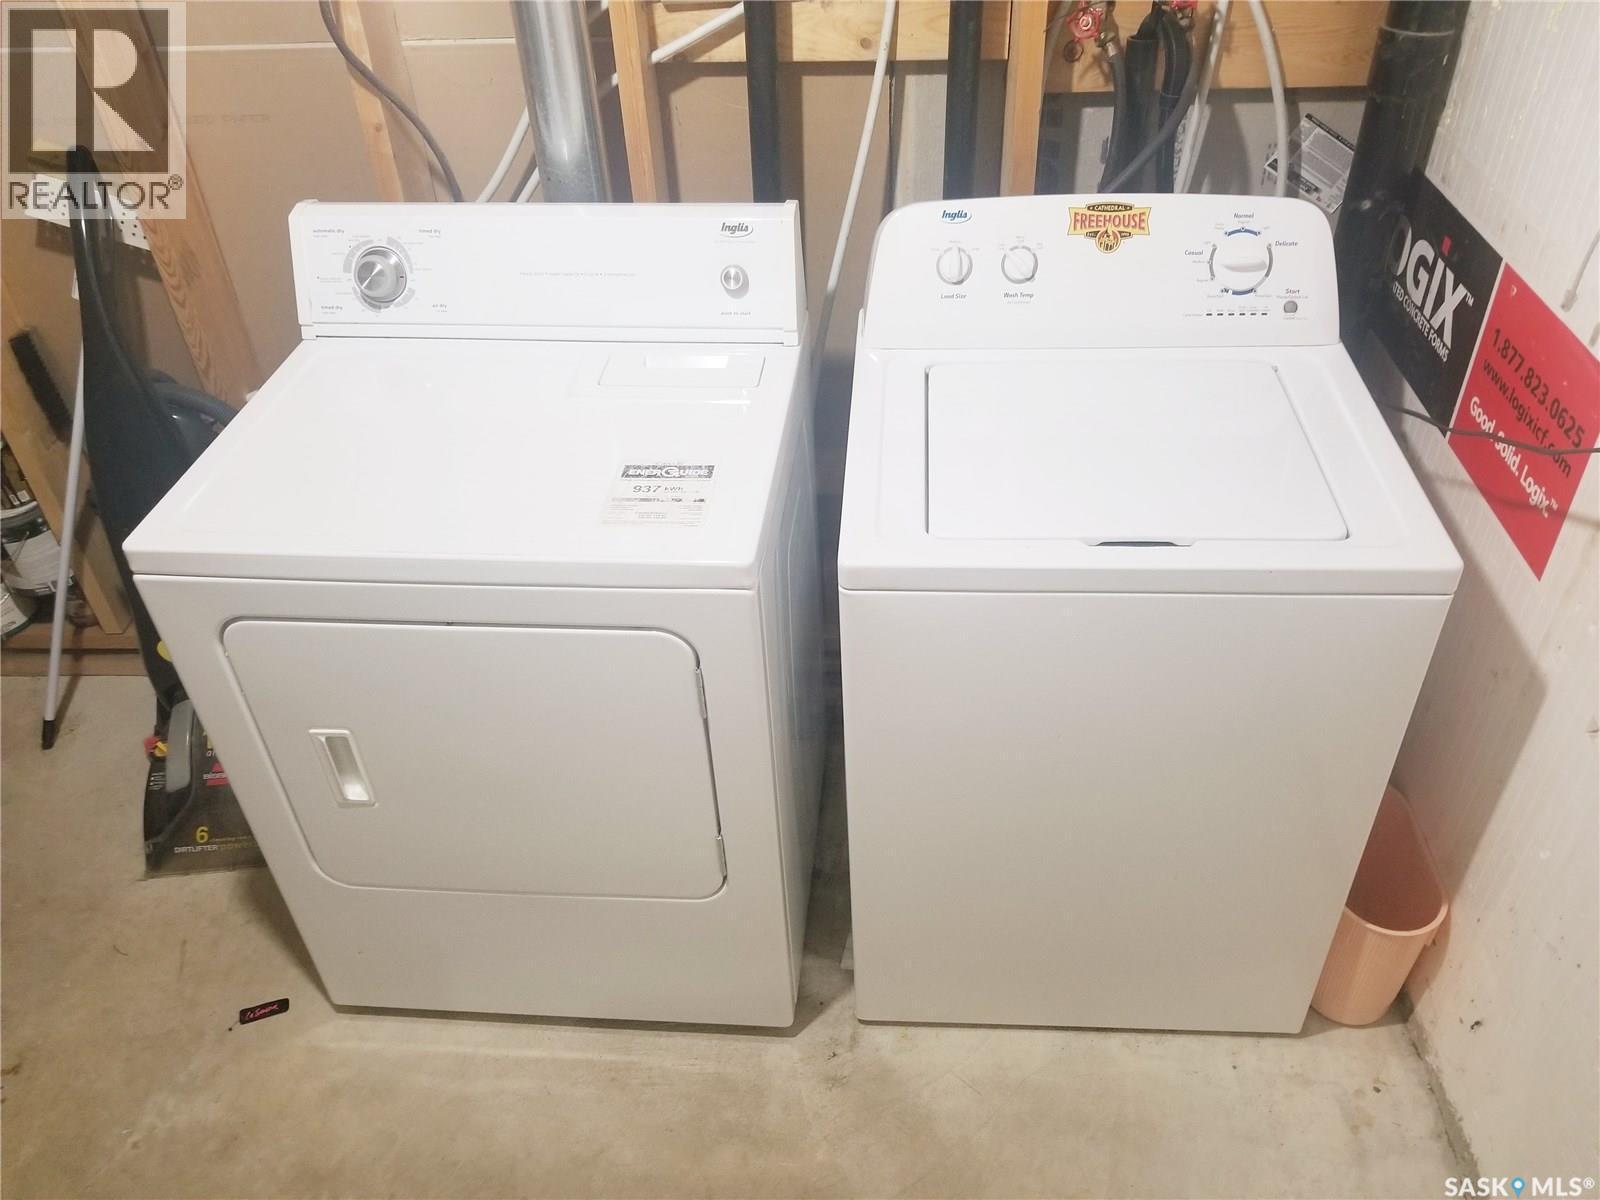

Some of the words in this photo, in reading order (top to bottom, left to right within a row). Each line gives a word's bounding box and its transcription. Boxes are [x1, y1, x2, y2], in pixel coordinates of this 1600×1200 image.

[1094, 204, 1126, 212] CATHEDRAL
[941, 209, 969, 221] Inglis
[1073, 211, 1147, 231] FREEHOUSE
[1233, 212, 1255, 220] Normal
[720, 222, 750, 235] Inglis
[1274, 240, 1299, 248] Delicate
[1284, 287, 1301, 295] Start
[1392, 281, 1405, 302] TED
[1403, 295, 1431, 338] CONCRETE
[1428, 328, 1450, 362] FORMS
[1492, 328, 1585, 449] 1.877.823.0625
[632, 484, 662, 494] 937
[196, 826, 209, 843] 6
